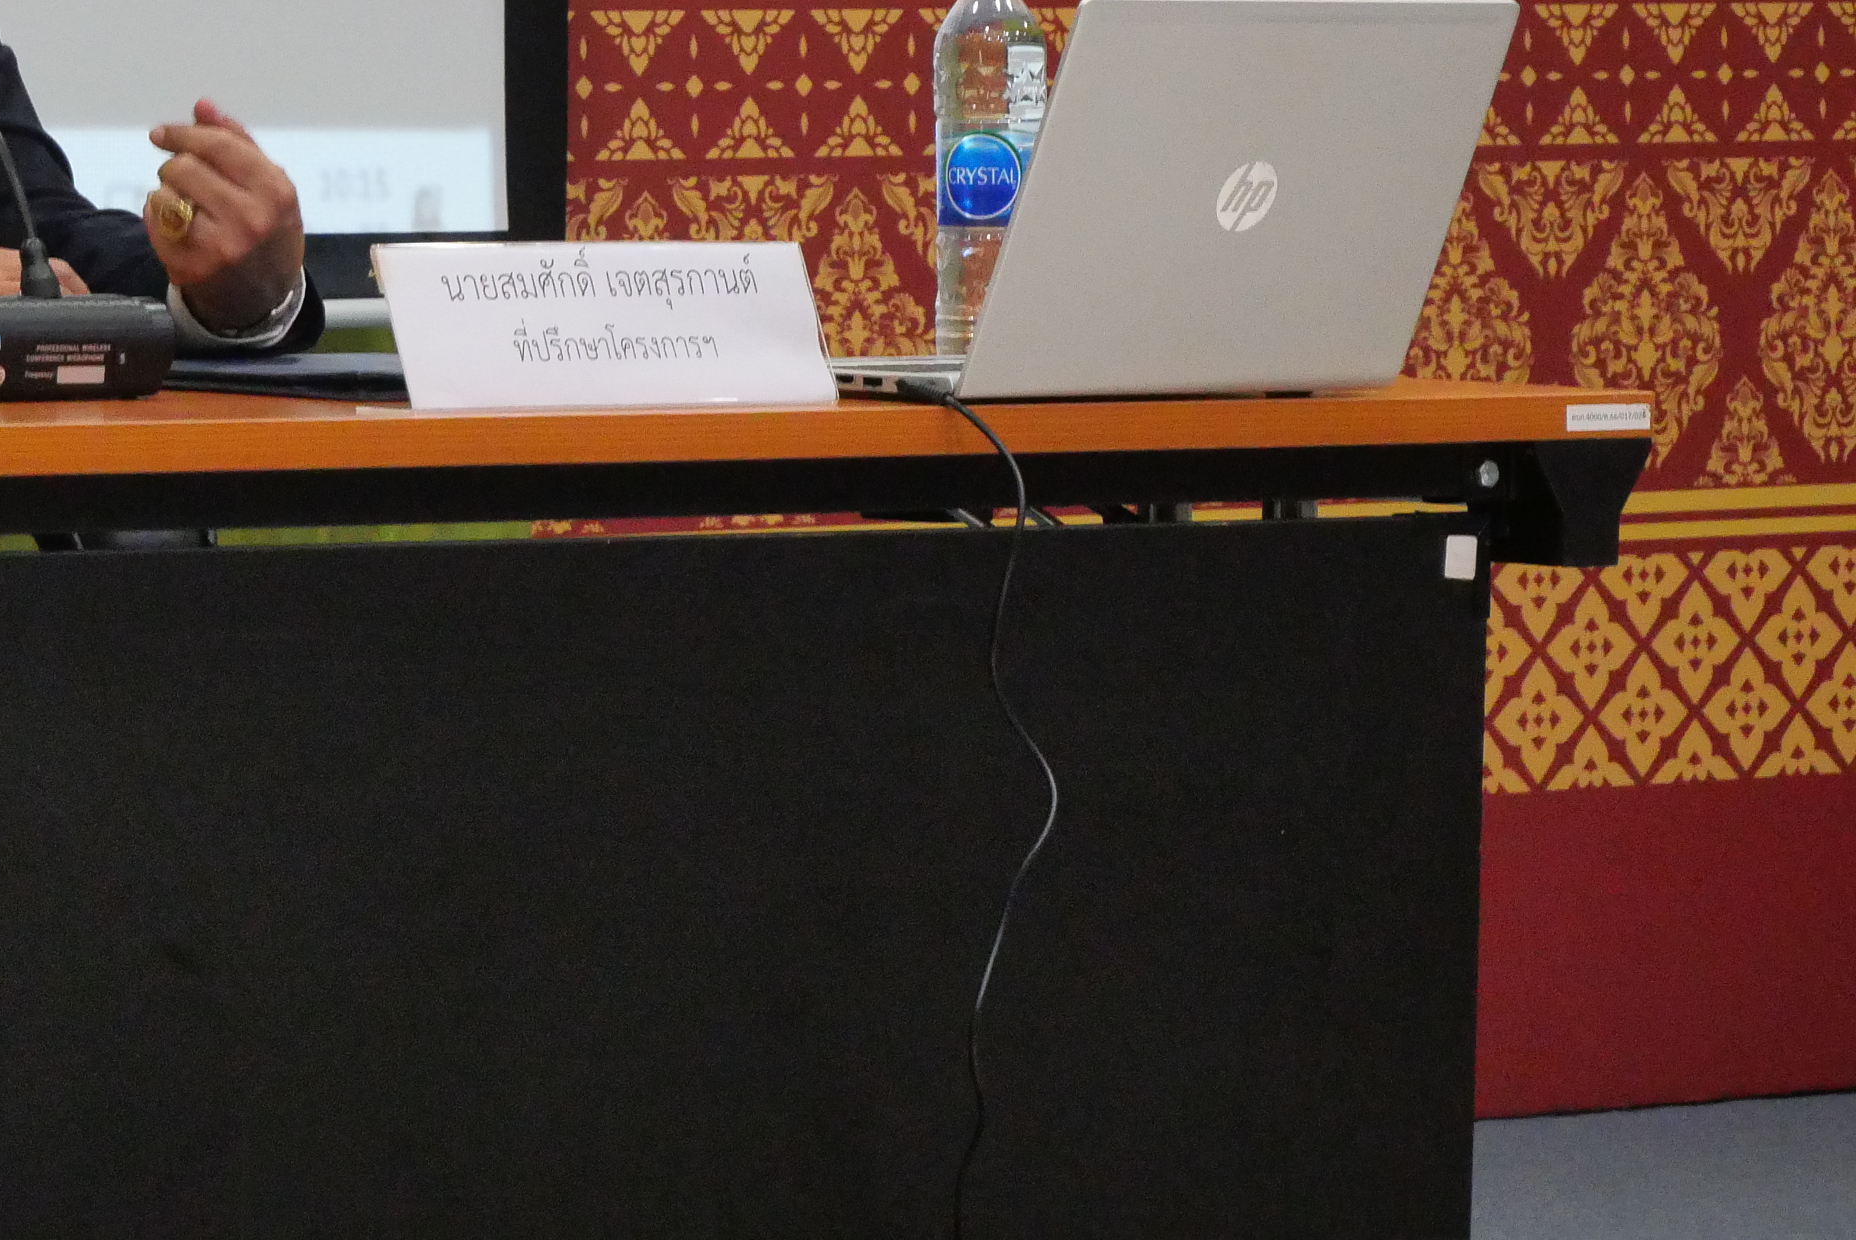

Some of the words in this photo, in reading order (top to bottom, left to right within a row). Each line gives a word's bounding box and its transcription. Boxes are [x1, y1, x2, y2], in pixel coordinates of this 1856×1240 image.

[948, 165, 1017, 187] CRYSTAL
[1218, 162, 1276, 230] hp
[440, 246, 597, 302] นายสมศักดิ์
[605, 252, 759, 310] เจตสุรกานต์
[512, 318, 720, 363] ที่ปรึกษาโครงการฯ
